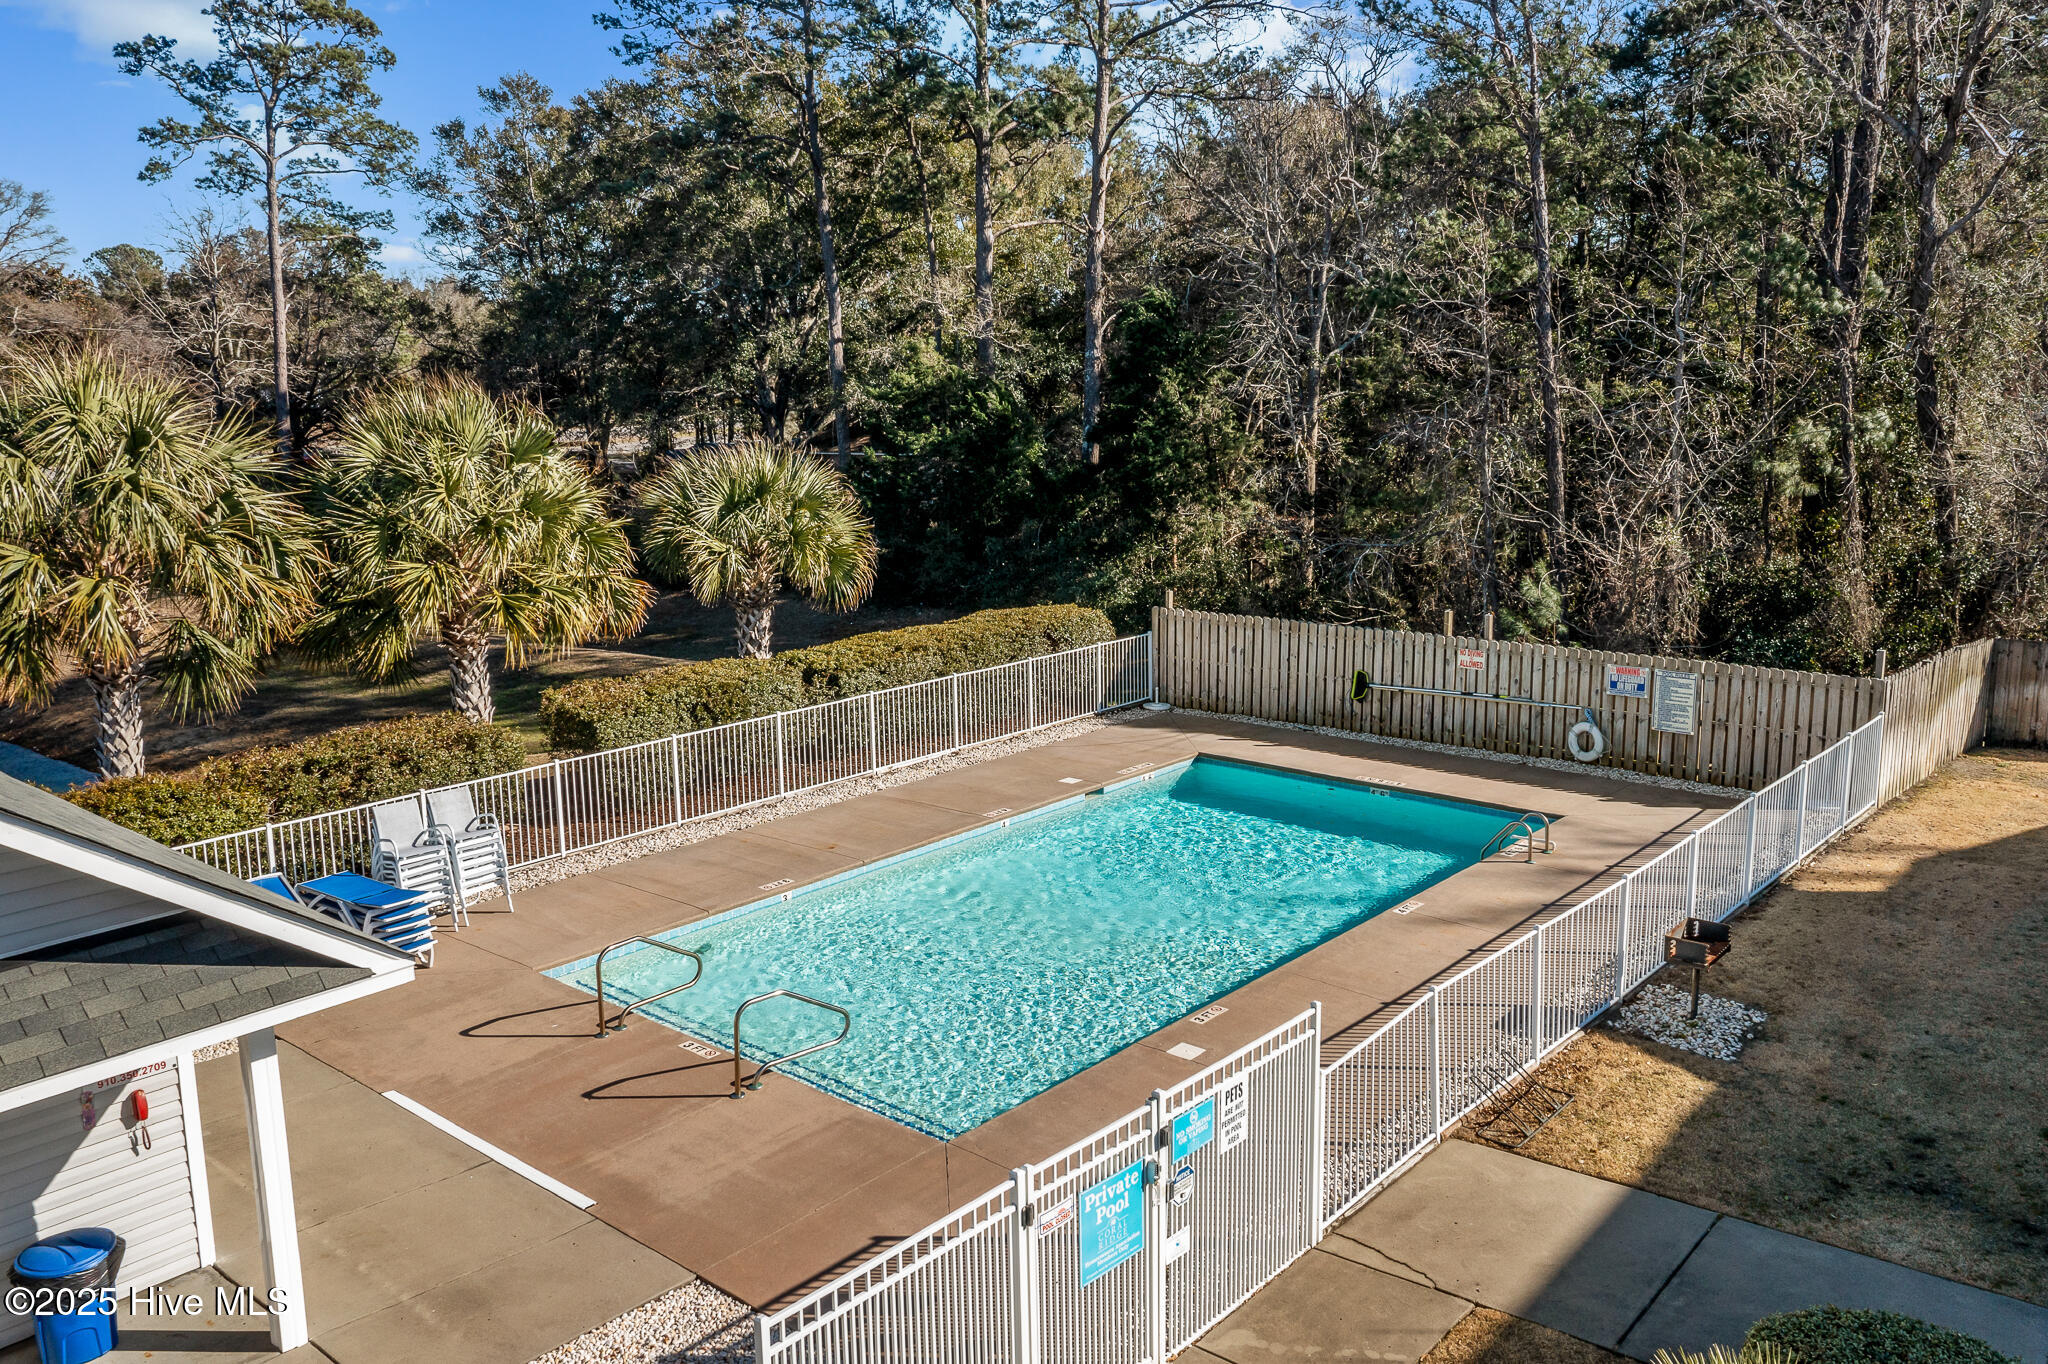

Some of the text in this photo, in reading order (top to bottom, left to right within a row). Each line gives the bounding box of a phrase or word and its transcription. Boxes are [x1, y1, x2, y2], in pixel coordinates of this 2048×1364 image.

[1460, 660, 1484, 669] ALLOWED
[1616, 667, 1640, 677] WARNING
[1201, 1010, 1216, 1018] FT
[691, 1045, 708, 1053] FT
[97, 1060, 167, 1089] 910.350.2709
[1225, 1082, 1243, 1106] PETS
[1224, 1106, 1234, 1117] ARE
[1221, 1109, 1246, 1130] PERMITTED
[1231, 1121, 1242, 1134] POOL
[1175, 1130, 1185, 1141] NO
[1227, 1133, 1240, 1145] AREA
[1084, 1171, 1139, 1213] Private
[1095, 1190, 1130, 1225] Pool
